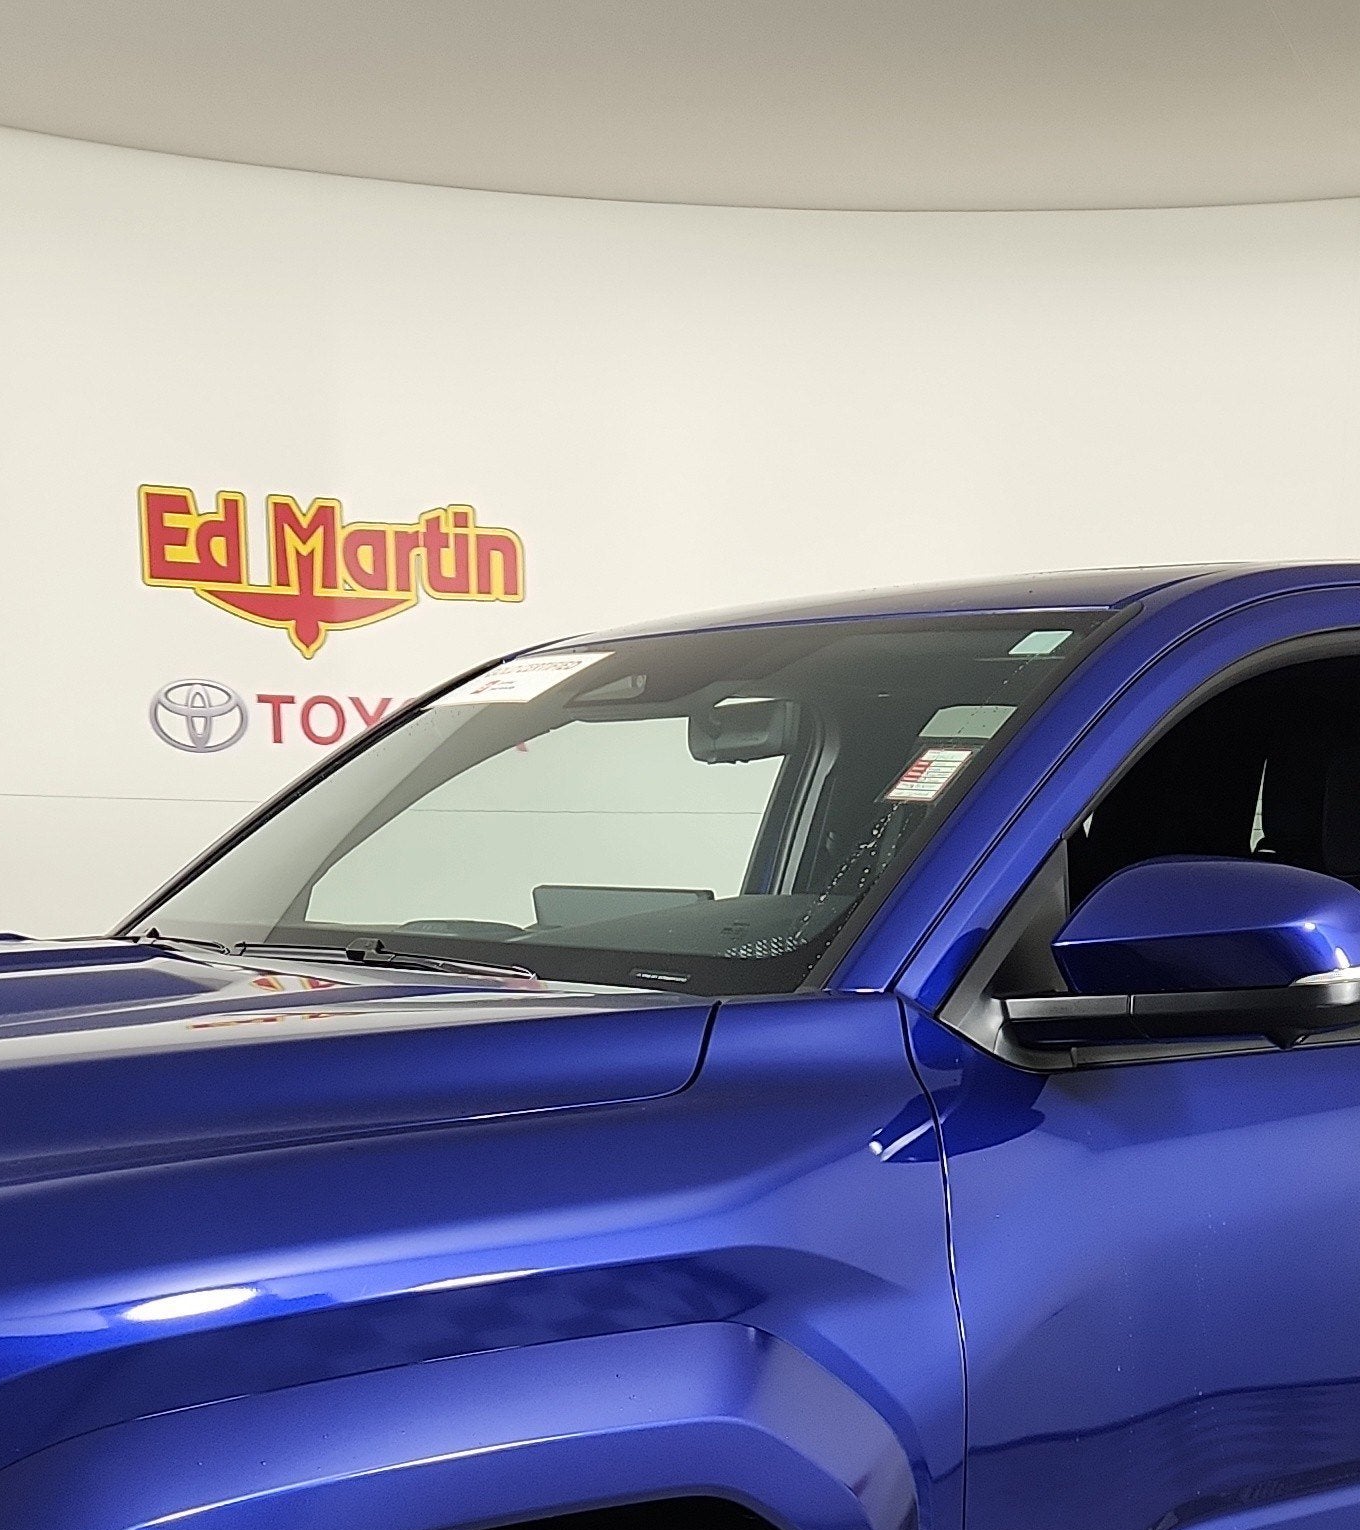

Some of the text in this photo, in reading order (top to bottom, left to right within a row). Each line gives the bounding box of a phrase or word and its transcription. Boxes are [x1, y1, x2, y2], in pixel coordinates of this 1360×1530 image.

[138, 484, 524, 602] Ed Martin
[255, 692, 422, 746] TOY
